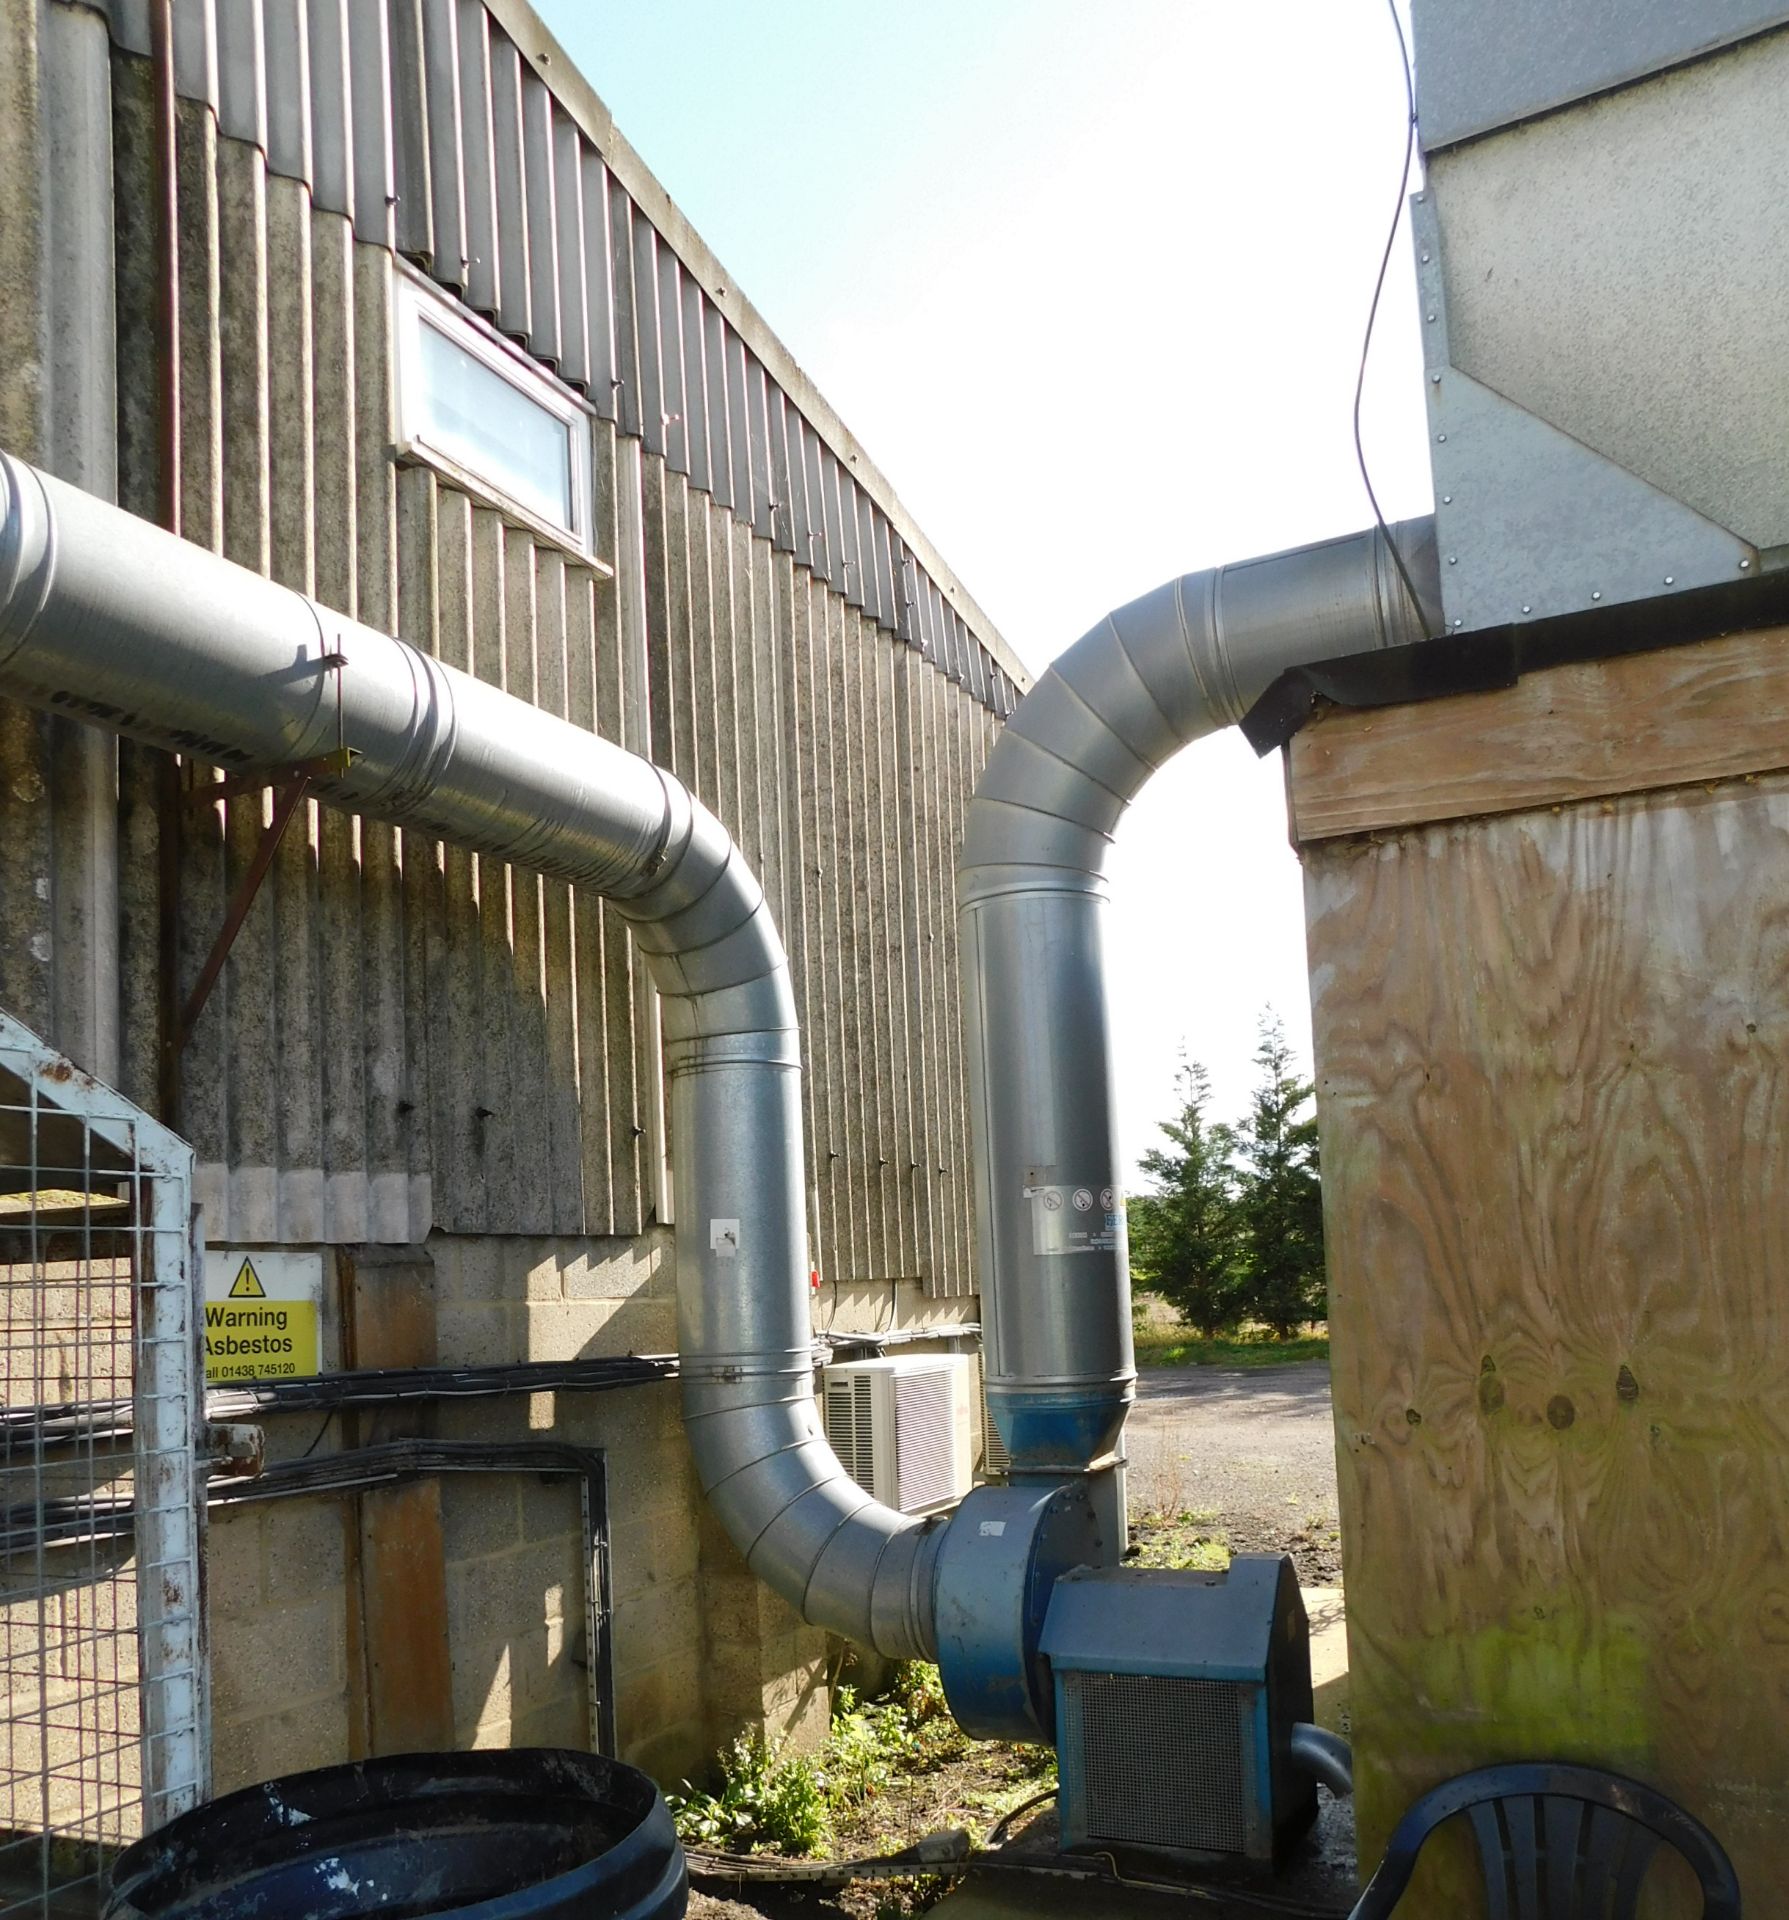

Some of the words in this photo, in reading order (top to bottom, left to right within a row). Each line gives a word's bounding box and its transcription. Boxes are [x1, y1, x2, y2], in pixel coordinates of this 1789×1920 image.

[205, 1306, 287, 1330] Warning
[205, 1366, 219, 1379] all
[221, 1364, 255, 1378] 01438
[258, 1362, 296, 1376] 745120
